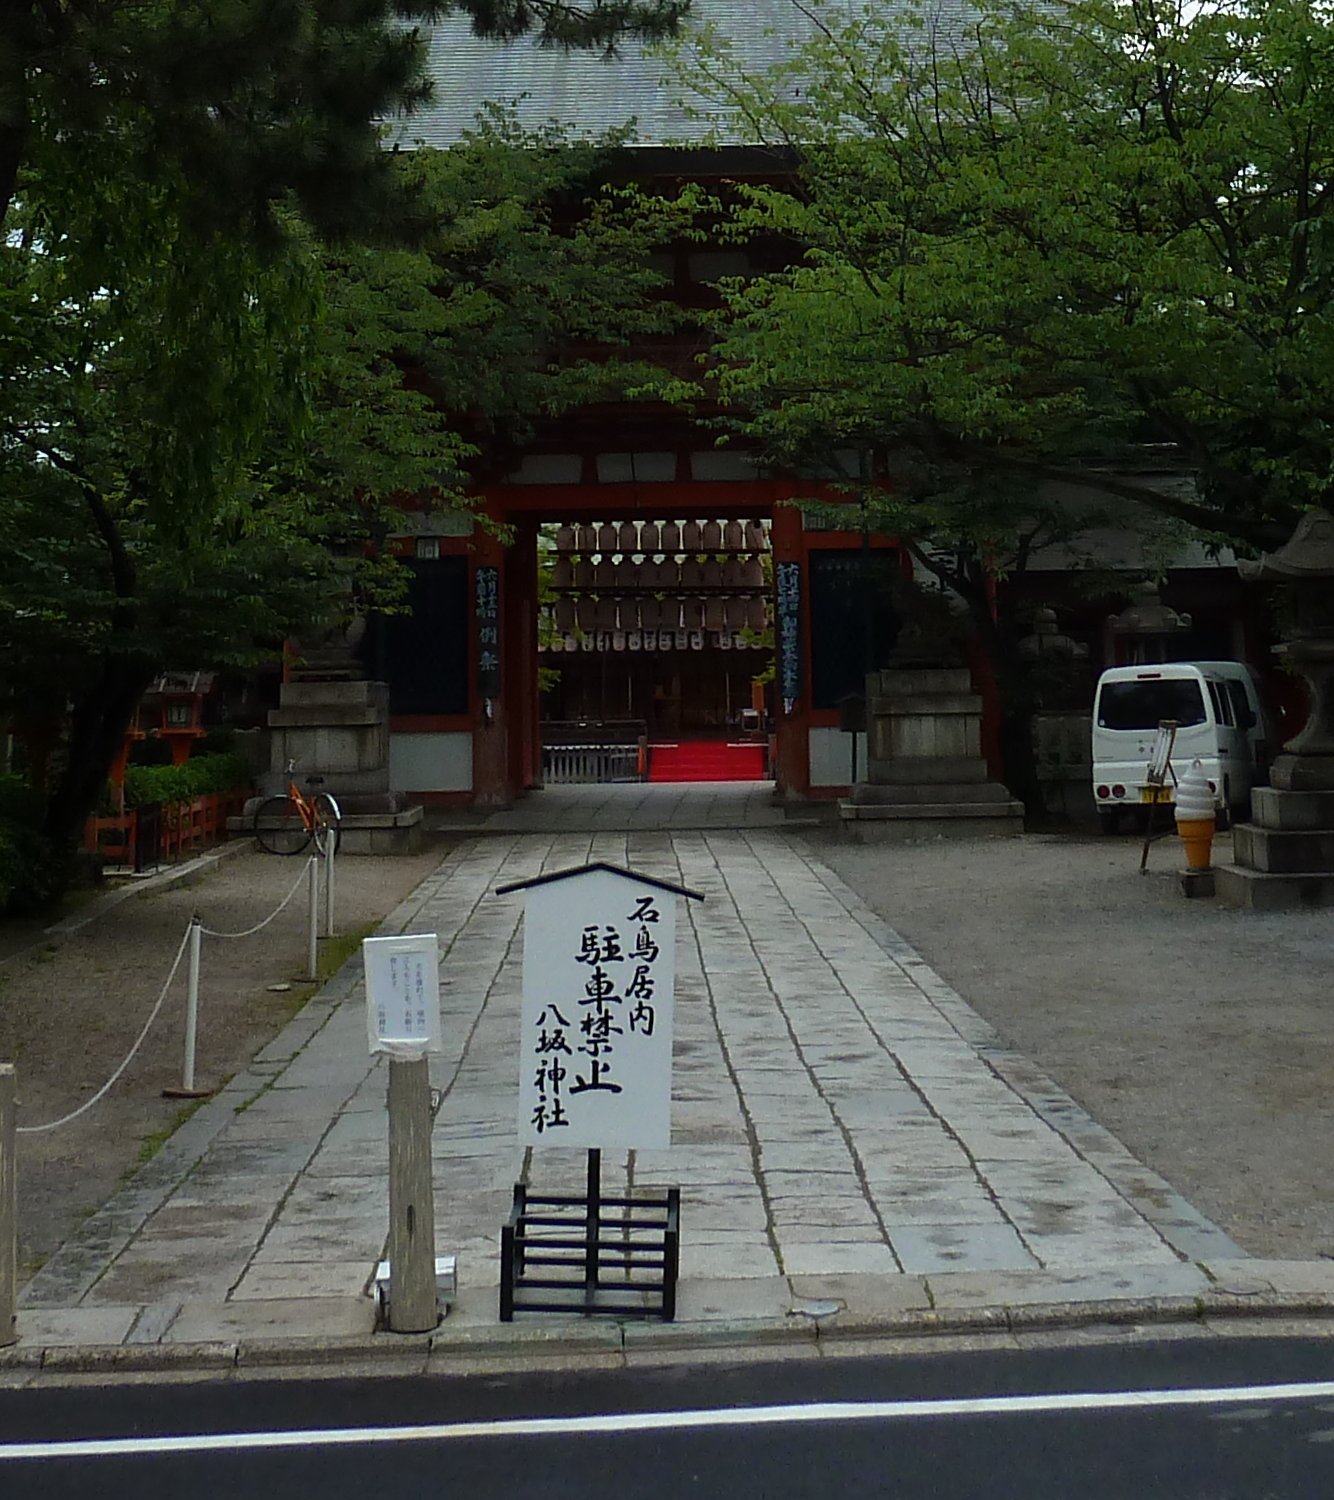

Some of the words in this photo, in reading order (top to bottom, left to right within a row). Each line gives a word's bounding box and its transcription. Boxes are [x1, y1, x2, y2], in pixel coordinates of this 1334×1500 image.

[568, 924, 625, 1095] 駐車禁止
[625, 896, 660, 1037] 石鳥居内
[530, 1003, 573, 1134] 八坂神社
